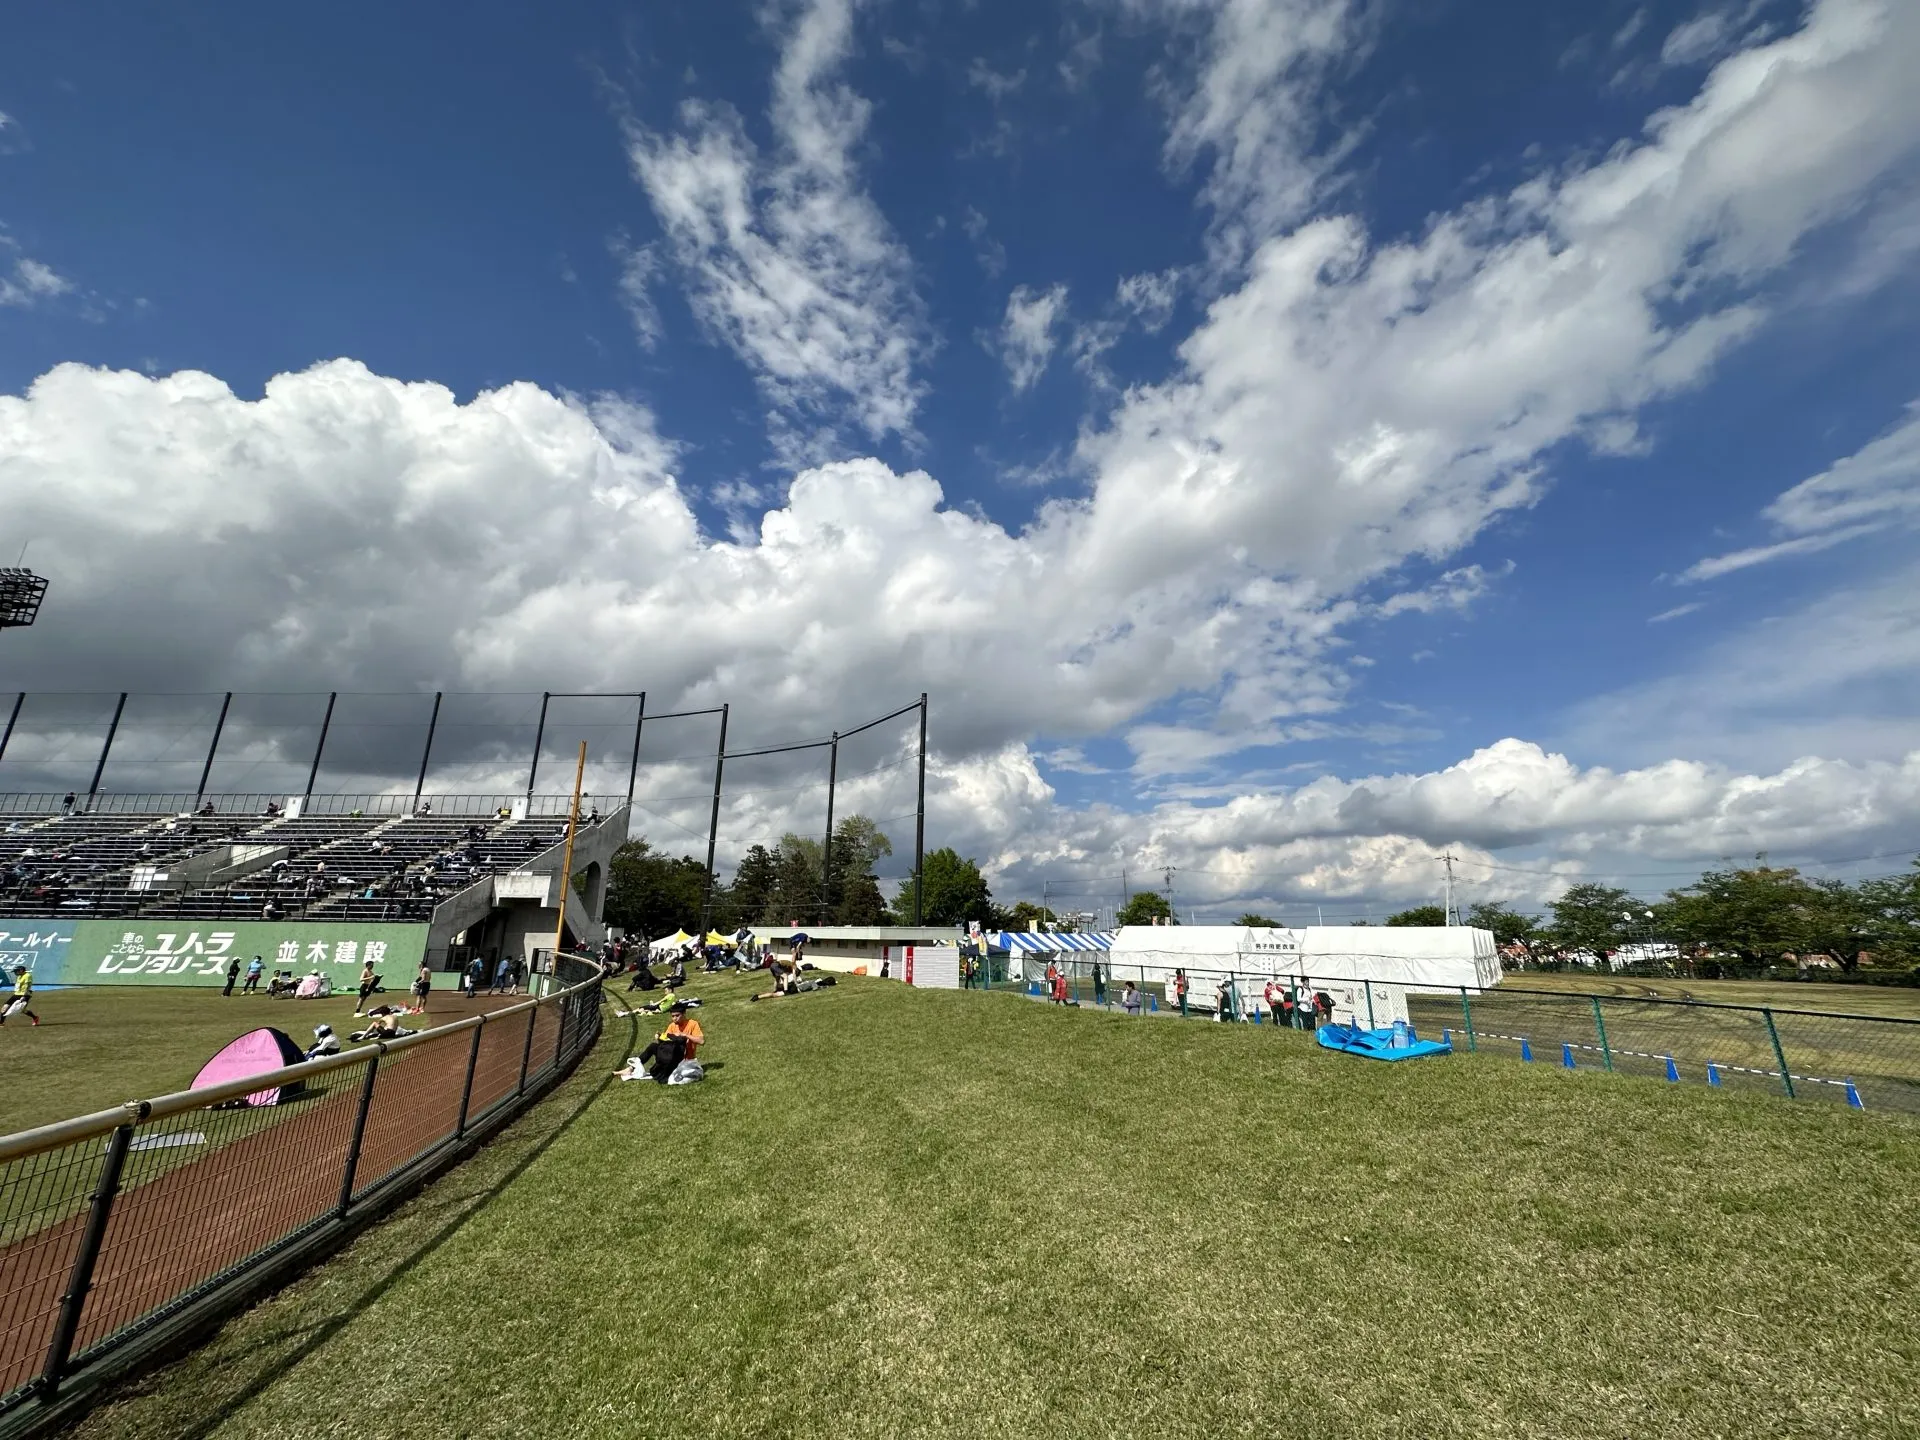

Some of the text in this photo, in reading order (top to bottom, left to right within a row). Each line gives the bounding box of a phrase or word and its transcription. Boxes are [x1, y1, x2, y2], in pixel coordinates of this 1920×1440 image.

[122, 932, 144, 944] 車の
[144, 932, 236, 955] ユハラ
[111, 944, 145, 954] ことなら
[275, 940, 388, 963] 並木建設
[96, 955, 229, 975] レンタリース
